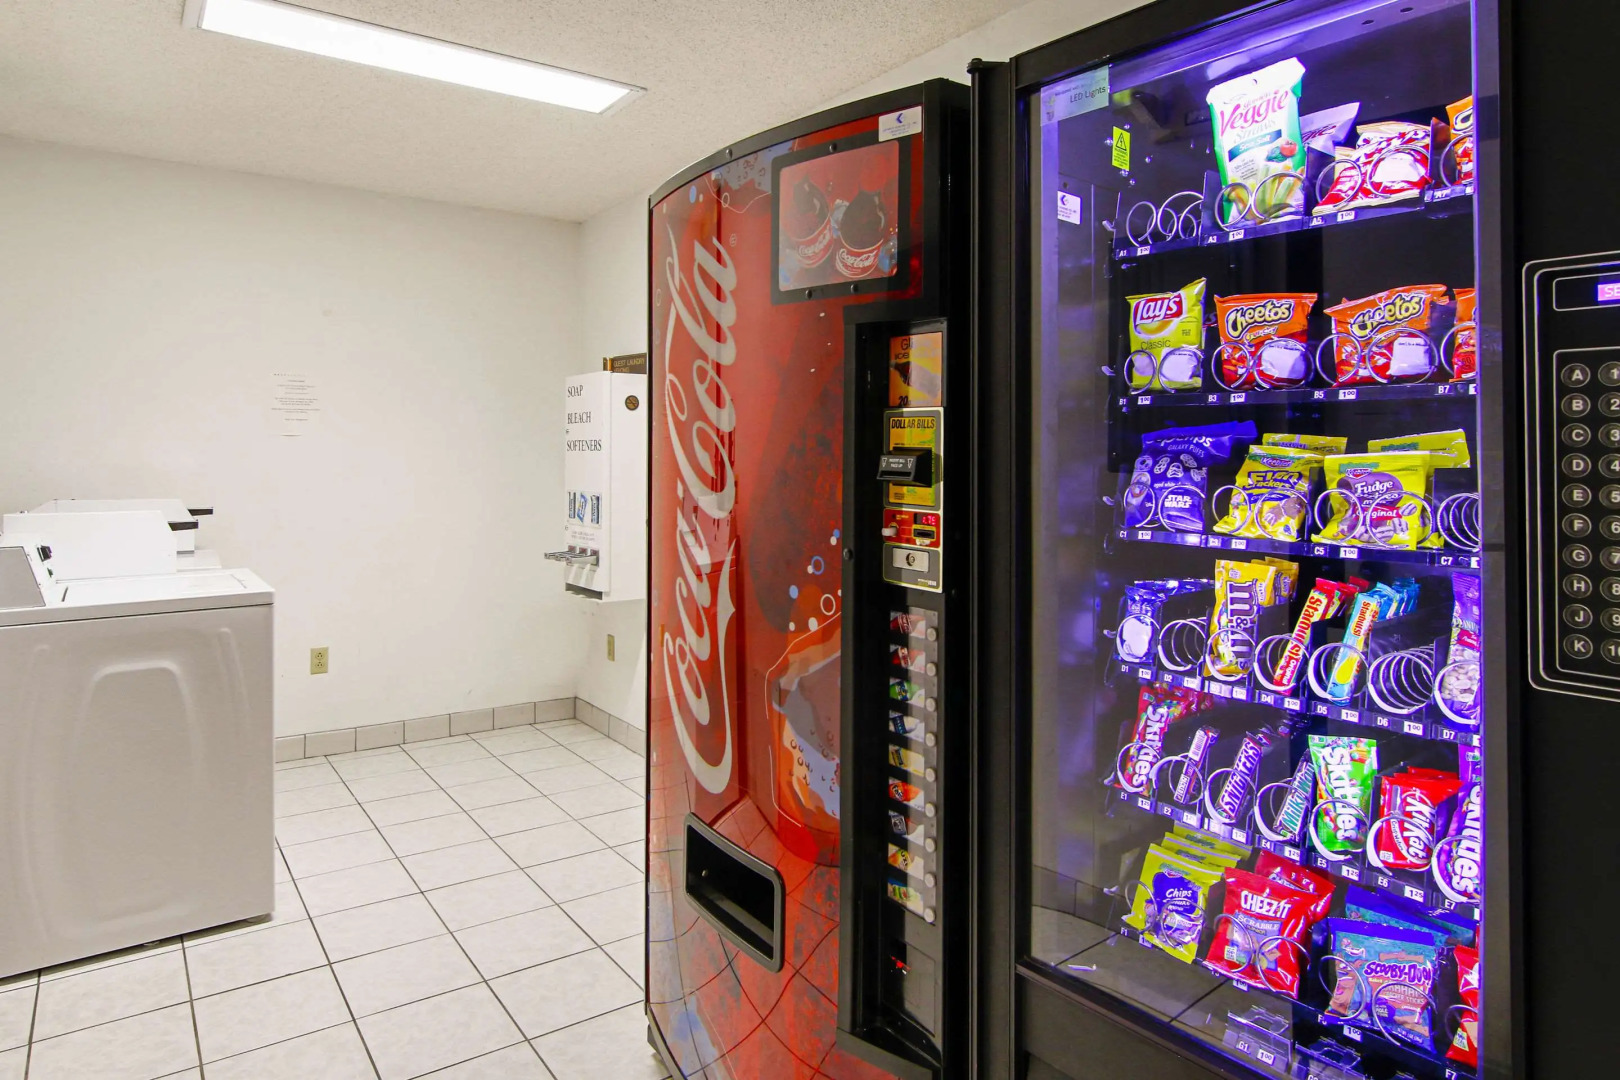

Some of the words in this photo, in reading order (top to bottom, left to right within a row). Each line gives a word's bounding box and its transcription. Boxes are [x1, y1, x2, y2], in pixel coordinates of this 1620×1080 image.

[1219, 90, 1289, 137] Veggie
[1136, 296, 1180, 325] Lay's
[1226, 301, 1291, 339] Cheetos
[1351, 295, 1423, 339] Cheetos
[1140, 339, 1171, 351] Classic
[1571, 369, 1584, 381] A
[1610, 368, 1619, 379] 1
[567, 385, 584, 398] SOAP
[1314, 390, 1324, 399] B5
[1438, 385, 1449, 394] B7
[1572, 399, 1584, 411] B
[1610, 399, 1620, 411] 2
[567, 411, 592, 425] BLEACH
[891, 419, 915, 429] DOLLAR
[917, 418, 935, 429] BILLS
[1571, 429, 1584, 441] C
[1610, 429, 1620, 441] 3
[566, 439, 602, 452] SOFTENERS
[1189, 445, 1205, 457] PUFFS
[1572, 459, 1584, 471] D
[1610, 460, 1620, 471] 4
[1355, 480, 1394, 496] Fudge
[1167, 494, 1191, 502] STAR
[1573, 490, 1584, 501] E
[1611, 491, 1620, 503] 5
[664, 222, 737, 794] Coca-Cola
[1164, 501, 1193, 509] WARS
[1573, 520, 1584, 531] F
[1611, 522, 1620, 534] 6
[1314, 546, 1325, 555] C5
[1572, 550, 1585, 562] G
[1441, 556, 1453, 565] C7
[1611, 553, 1620, 564] 7
[1573, 581, 1585, 592] H
[1611, 584, 1620, 595] 8
[1352, 600, 1372, 637] Starburst
[1574, 611, 1584, 622] J
[1611, 615, 1620, 626] 9
[1287, 595, 1323, 662] Starburst
[1573, 640, 1586, 653] K
[1121, 664, 1129, 673] D1
[1164, 673, 1173, 682] D2
[1261, 694, 1271, 703] D4
[1317, 705, 1328, 714] D5
[1376, 717, 1389, 727] D6
[1443, 729, 1456, 740] D7
[1132, 705, 1169, 787] Skittles
[1220, 740, 1261, 815] SNICKERS
[1325, 746, 1361, 841] Skittles
[1164, 807, 1172, 816] E2
[1281, 790, 1309, 832] Milky
[1261, 839, 1271, 849] E4
[1317, 858, 1327, 868] E5
[1377, 876, 1389, 887] E6
[1165, 888, 1193, 898] Chips
[1445, 899, 1456, 910] E7
[1237, 914, 1280, 930] SCRABBLE
[1238, 1041, 1249, 1052] G1
[1445, 1068, 1457, 1079] F7
